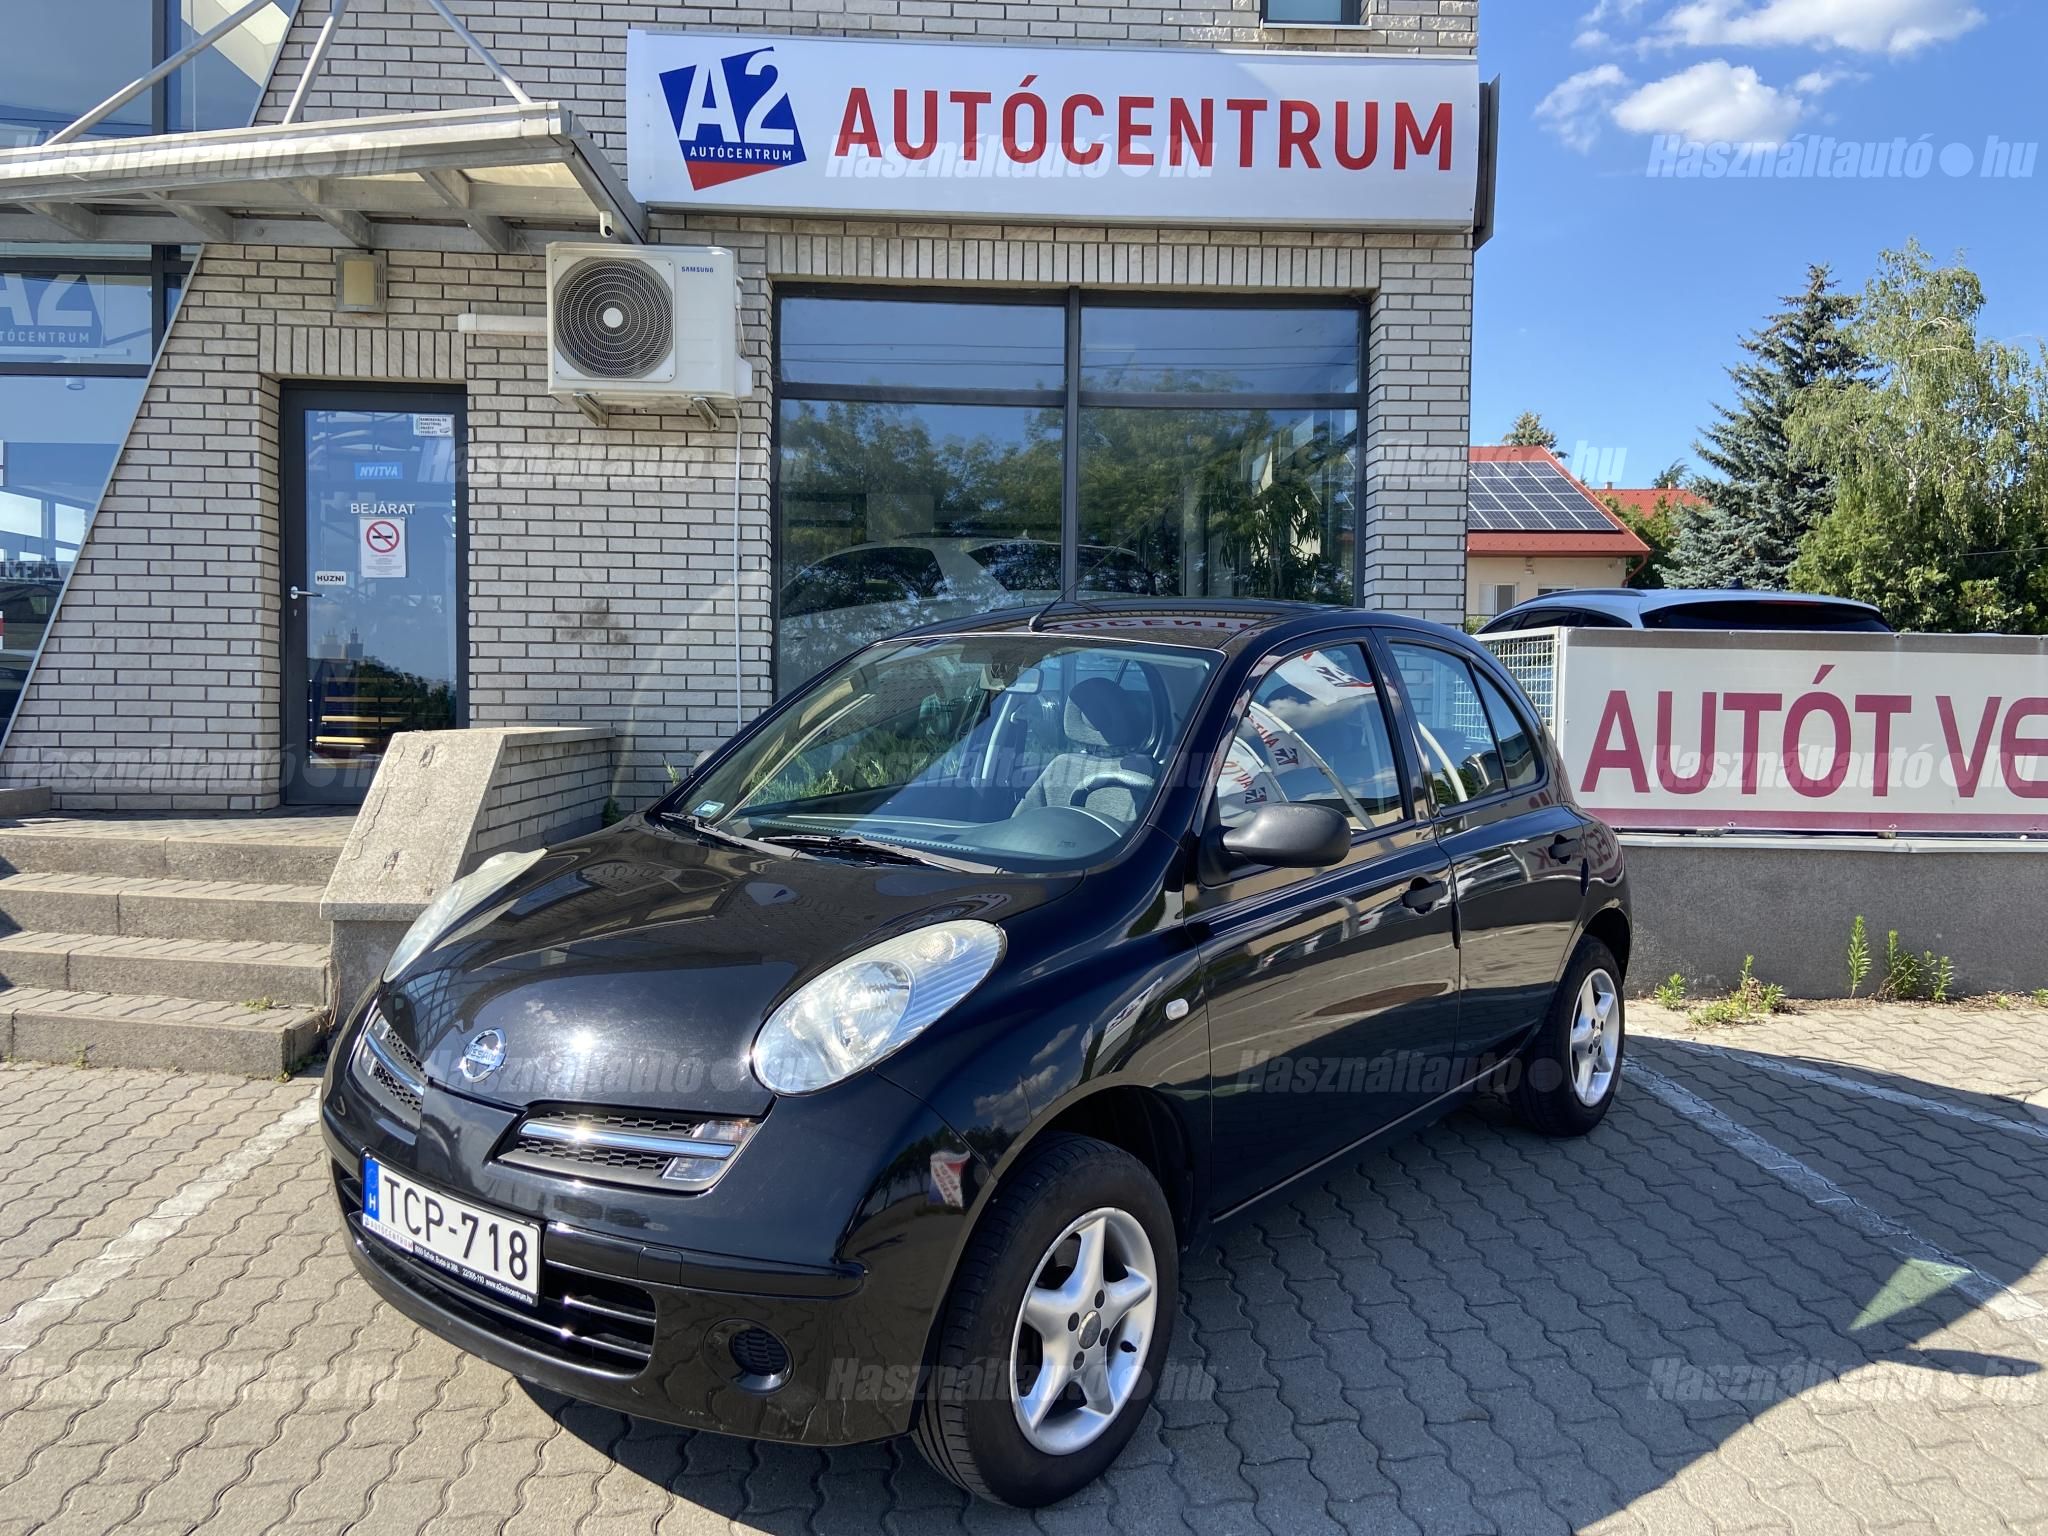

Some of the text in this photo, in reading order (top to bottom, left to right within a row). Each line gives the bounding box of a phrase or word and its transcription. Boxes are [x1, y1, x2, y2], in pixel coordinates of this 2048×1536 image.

[679, 50, 794, 146] A2
[835, 75, 1455, 171] AUTÓCENTRUM
[690, 145, 792, 161] AUTÓCENTRUM
[360, 466, 398, 477] NYITVA
[350, 501, 415, 514] BEJÁRAT
[1580, 664, 1912, 798] AUTÓT
[368, 1192, 376, 1212] H
[383, 1174, 528, 1281] TCP-718
